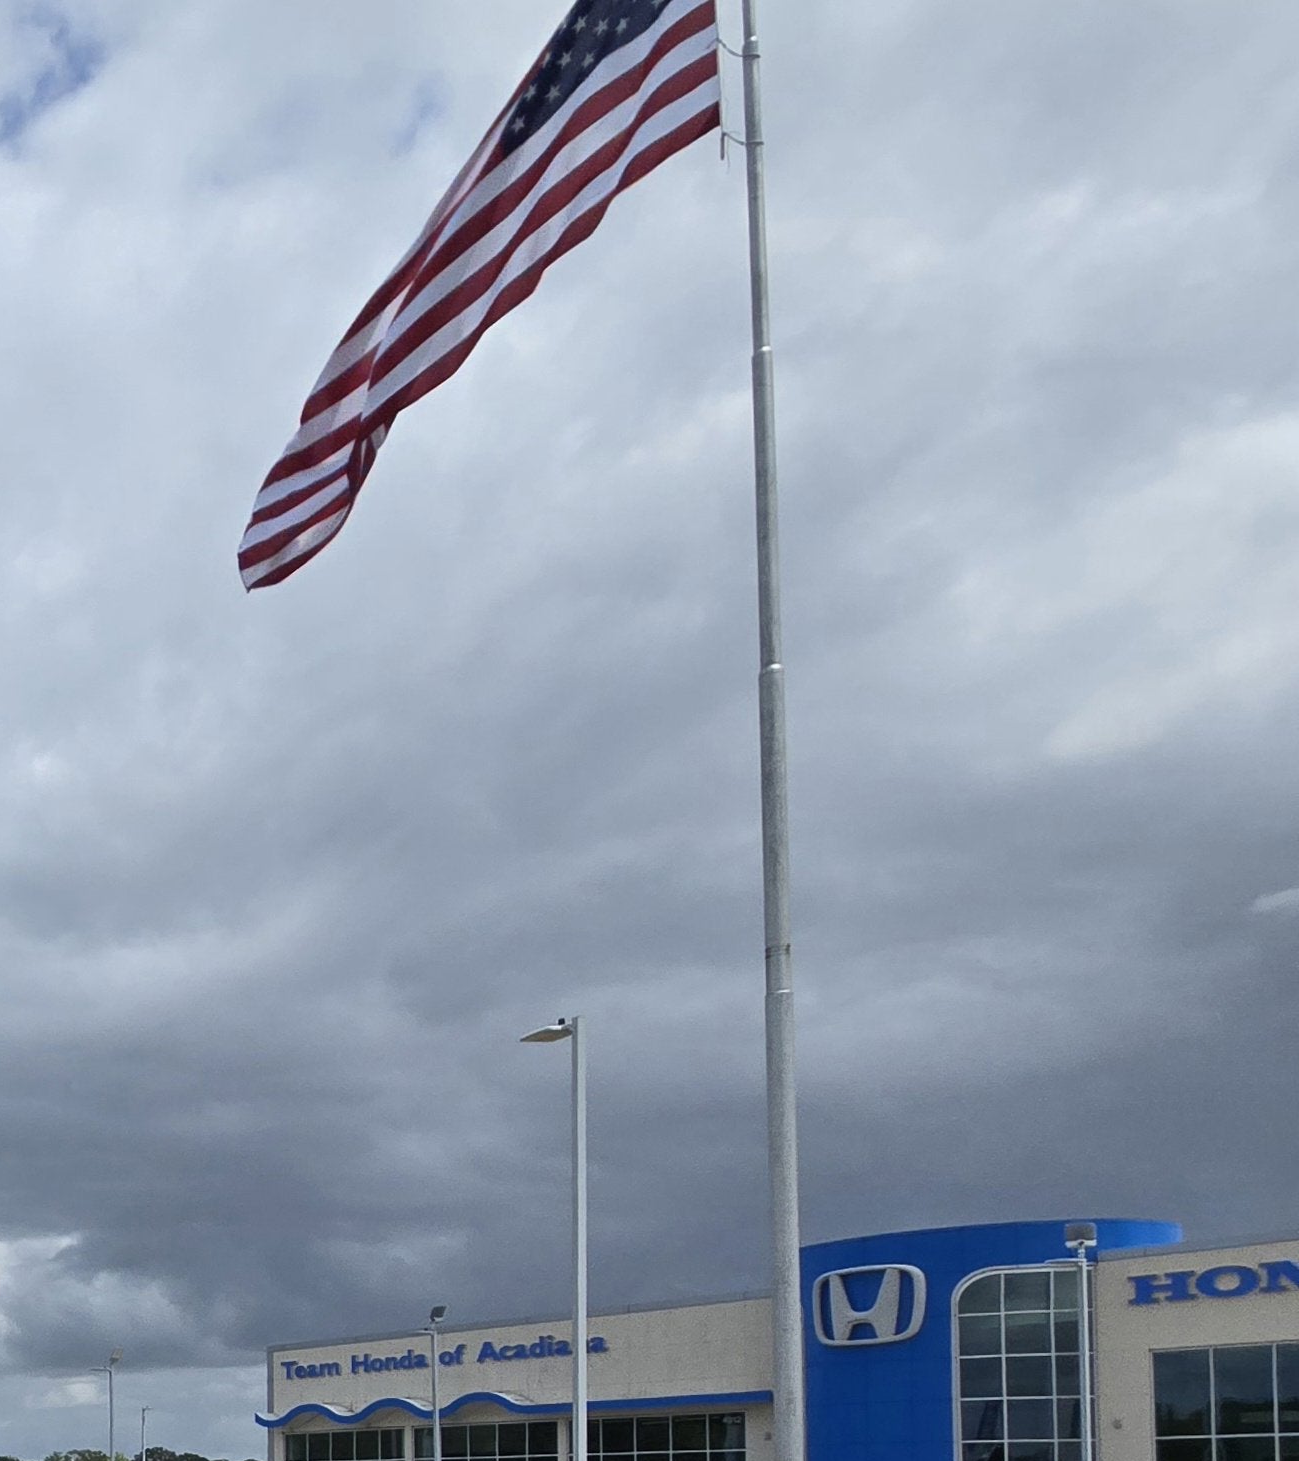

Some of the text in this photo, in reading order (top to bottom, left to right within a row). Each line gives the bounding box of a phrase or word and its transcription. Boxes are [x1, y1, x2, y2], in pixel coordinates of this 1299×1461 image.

[280, 1334, 609, 1380] Team Honda of Acadiaa
